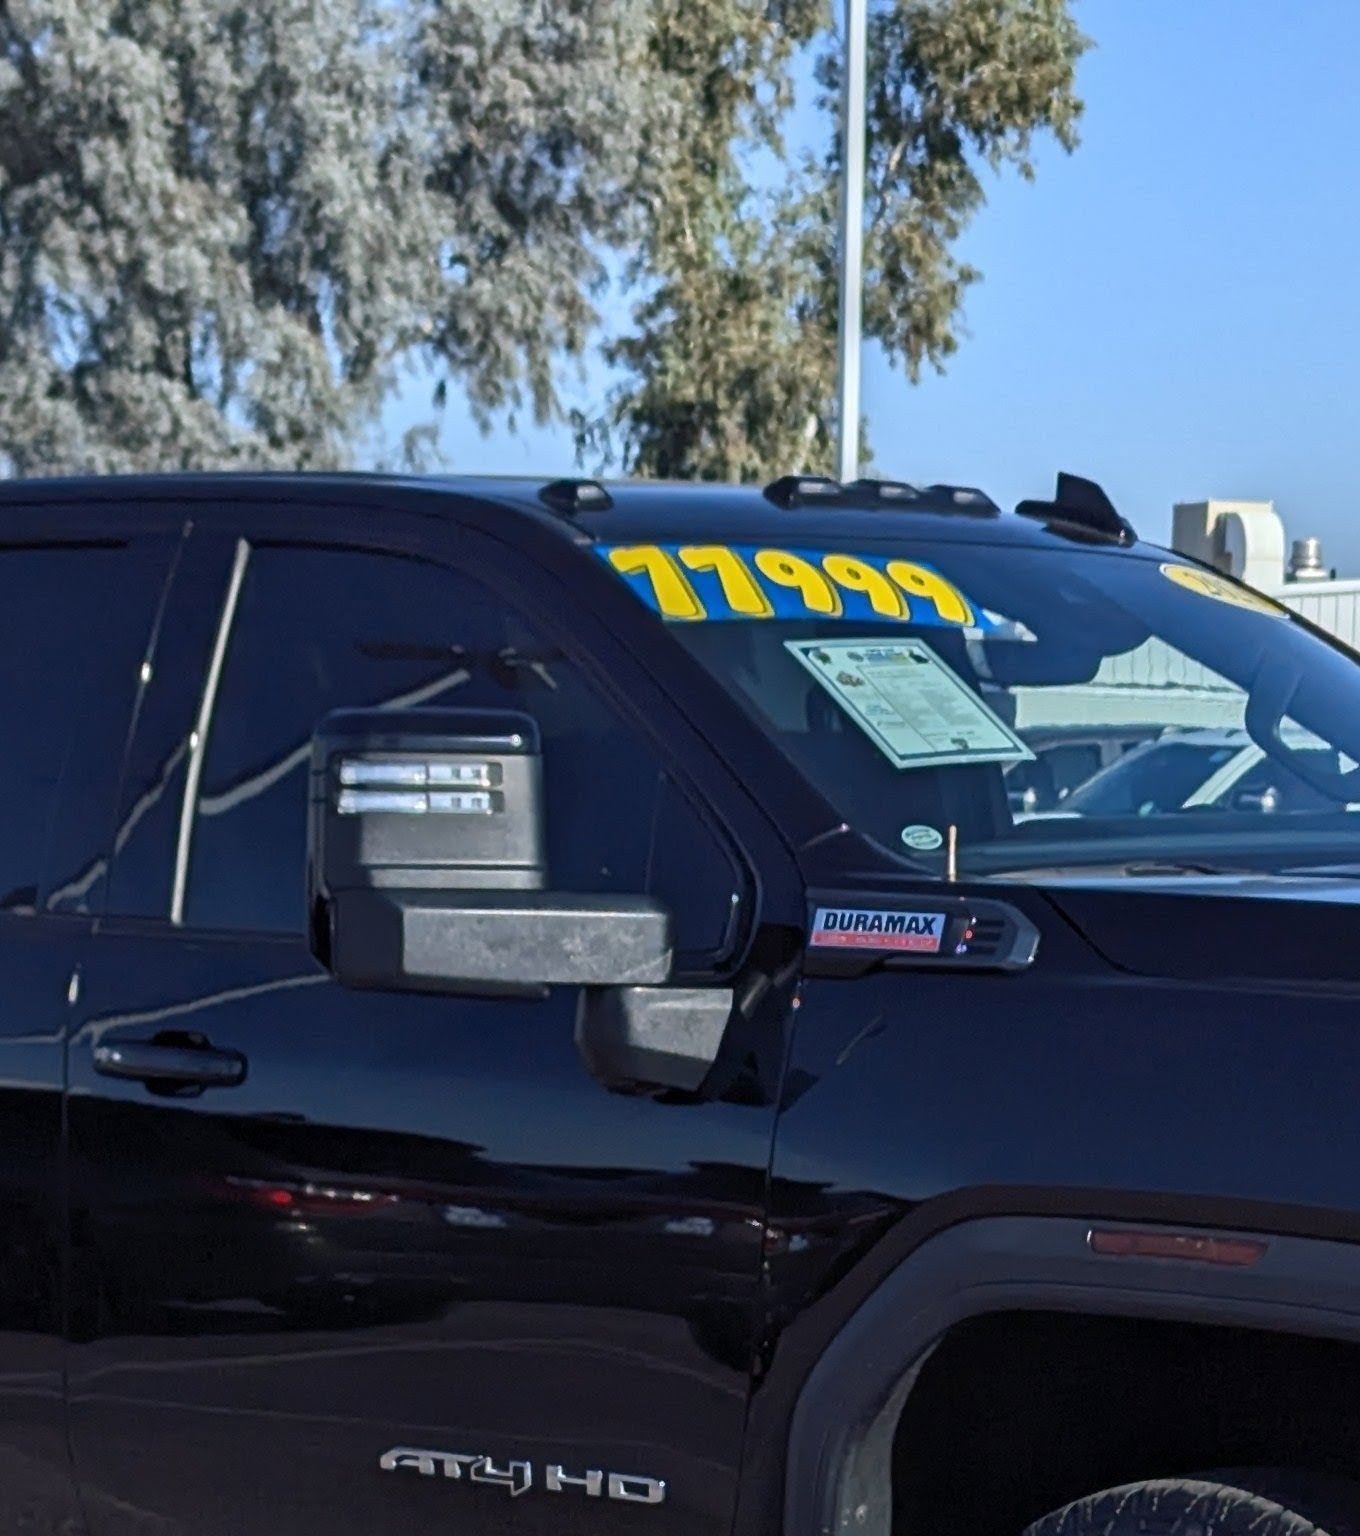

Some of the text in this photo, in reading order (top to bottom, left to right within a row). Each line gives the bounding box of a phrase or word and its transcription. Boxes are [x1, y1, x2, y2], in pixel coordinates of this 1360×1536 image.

[607, 544, 976, 628] 77999
[823, 911, 937, 936] DURAMAX
[380, 1446, 666, 1504] AT4 HD
